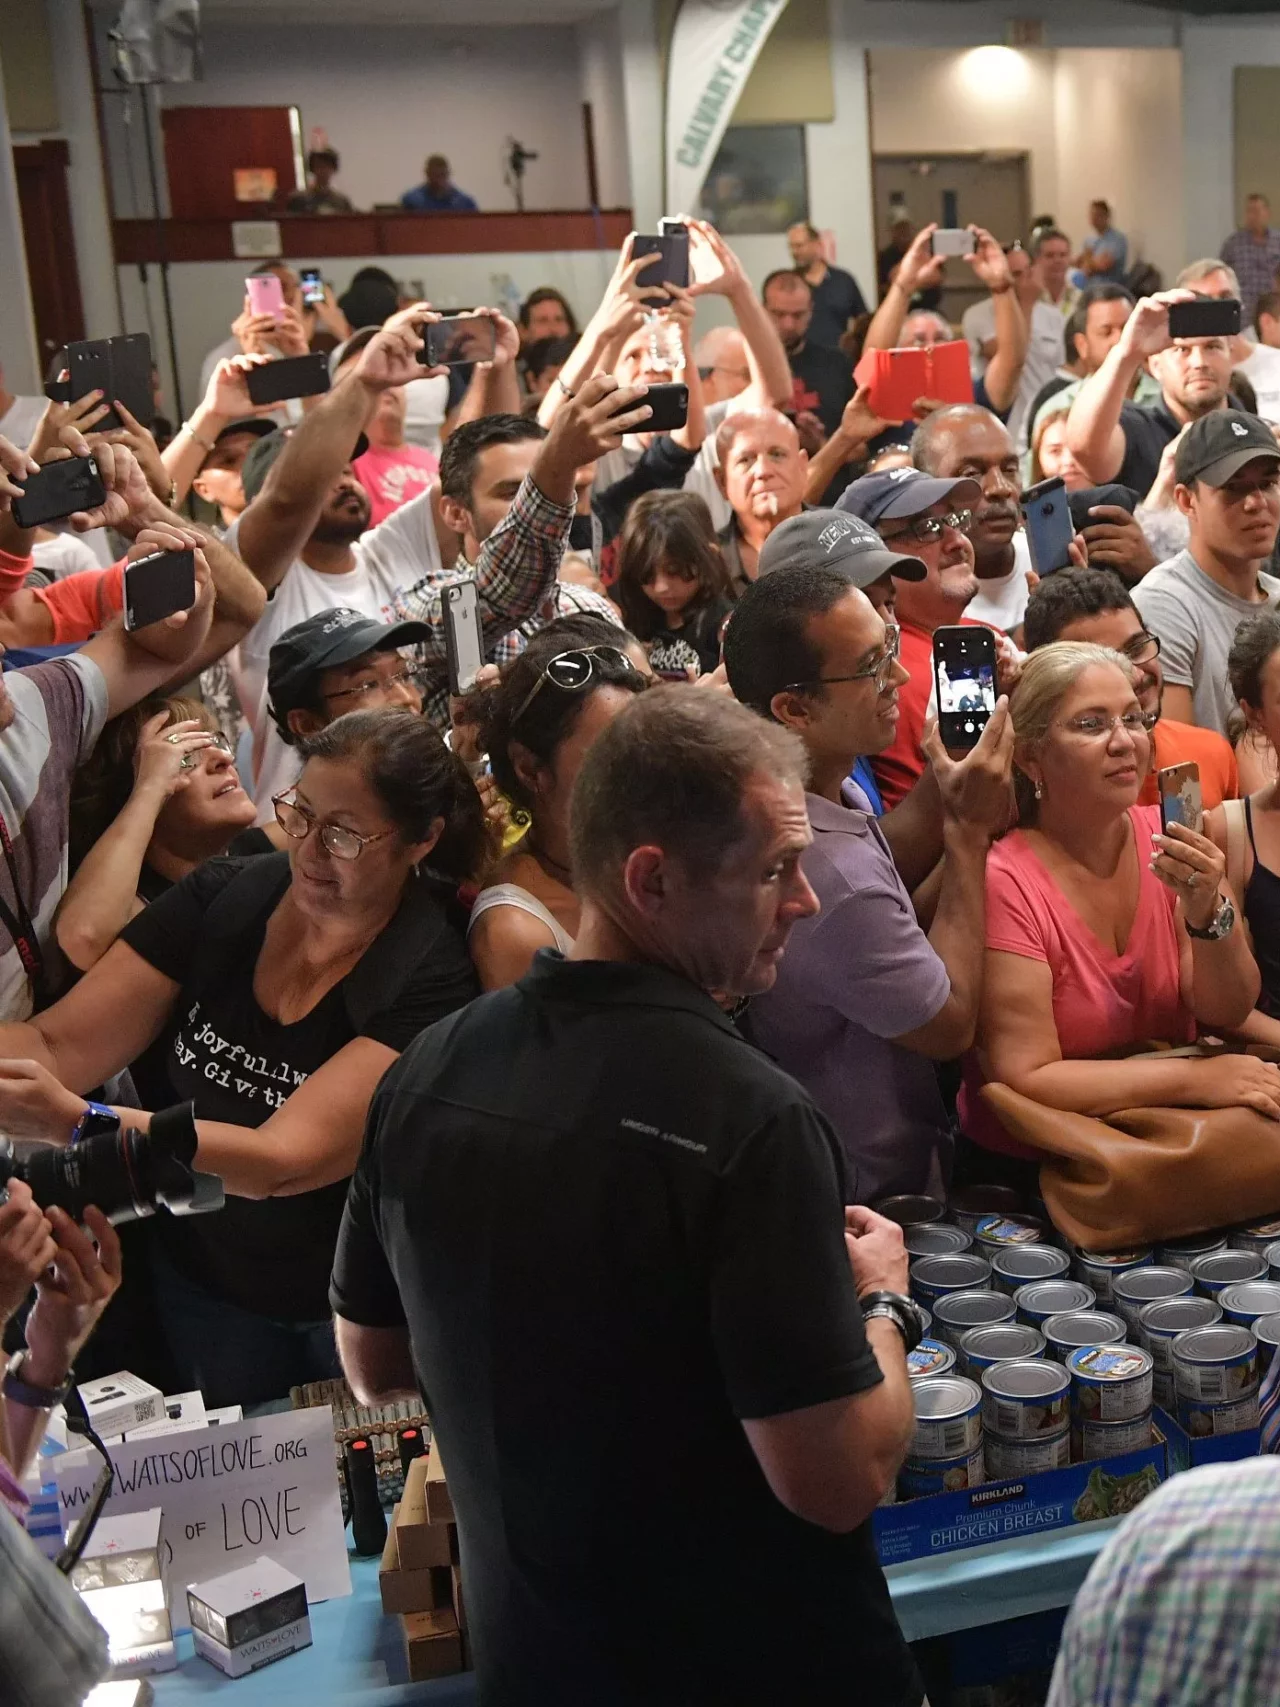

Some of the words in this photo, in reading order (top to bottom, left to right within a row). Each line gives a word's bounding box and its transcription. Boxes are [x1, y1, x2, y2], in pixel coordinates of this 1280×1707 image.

[675, 65, 737, 169] CALVARY
[722, 0, 770, 63] CHAP
[818, 518, 851, 554] NEW
[193, 1022, 270, 1077] joyful
[955, 1508, 1002, 1525] Premium
[1004, 1500, 1036, 1515] Chunk
[971, 1484, 1024, 1503] KIRKLAND
[185, 1521, 206, 1541] OF
[221, 1486, 306, 1552] LOVE
[931, 1520, 999, 1547] CHICKEN
[1004, 1506, 1064, 1532] BREAST
